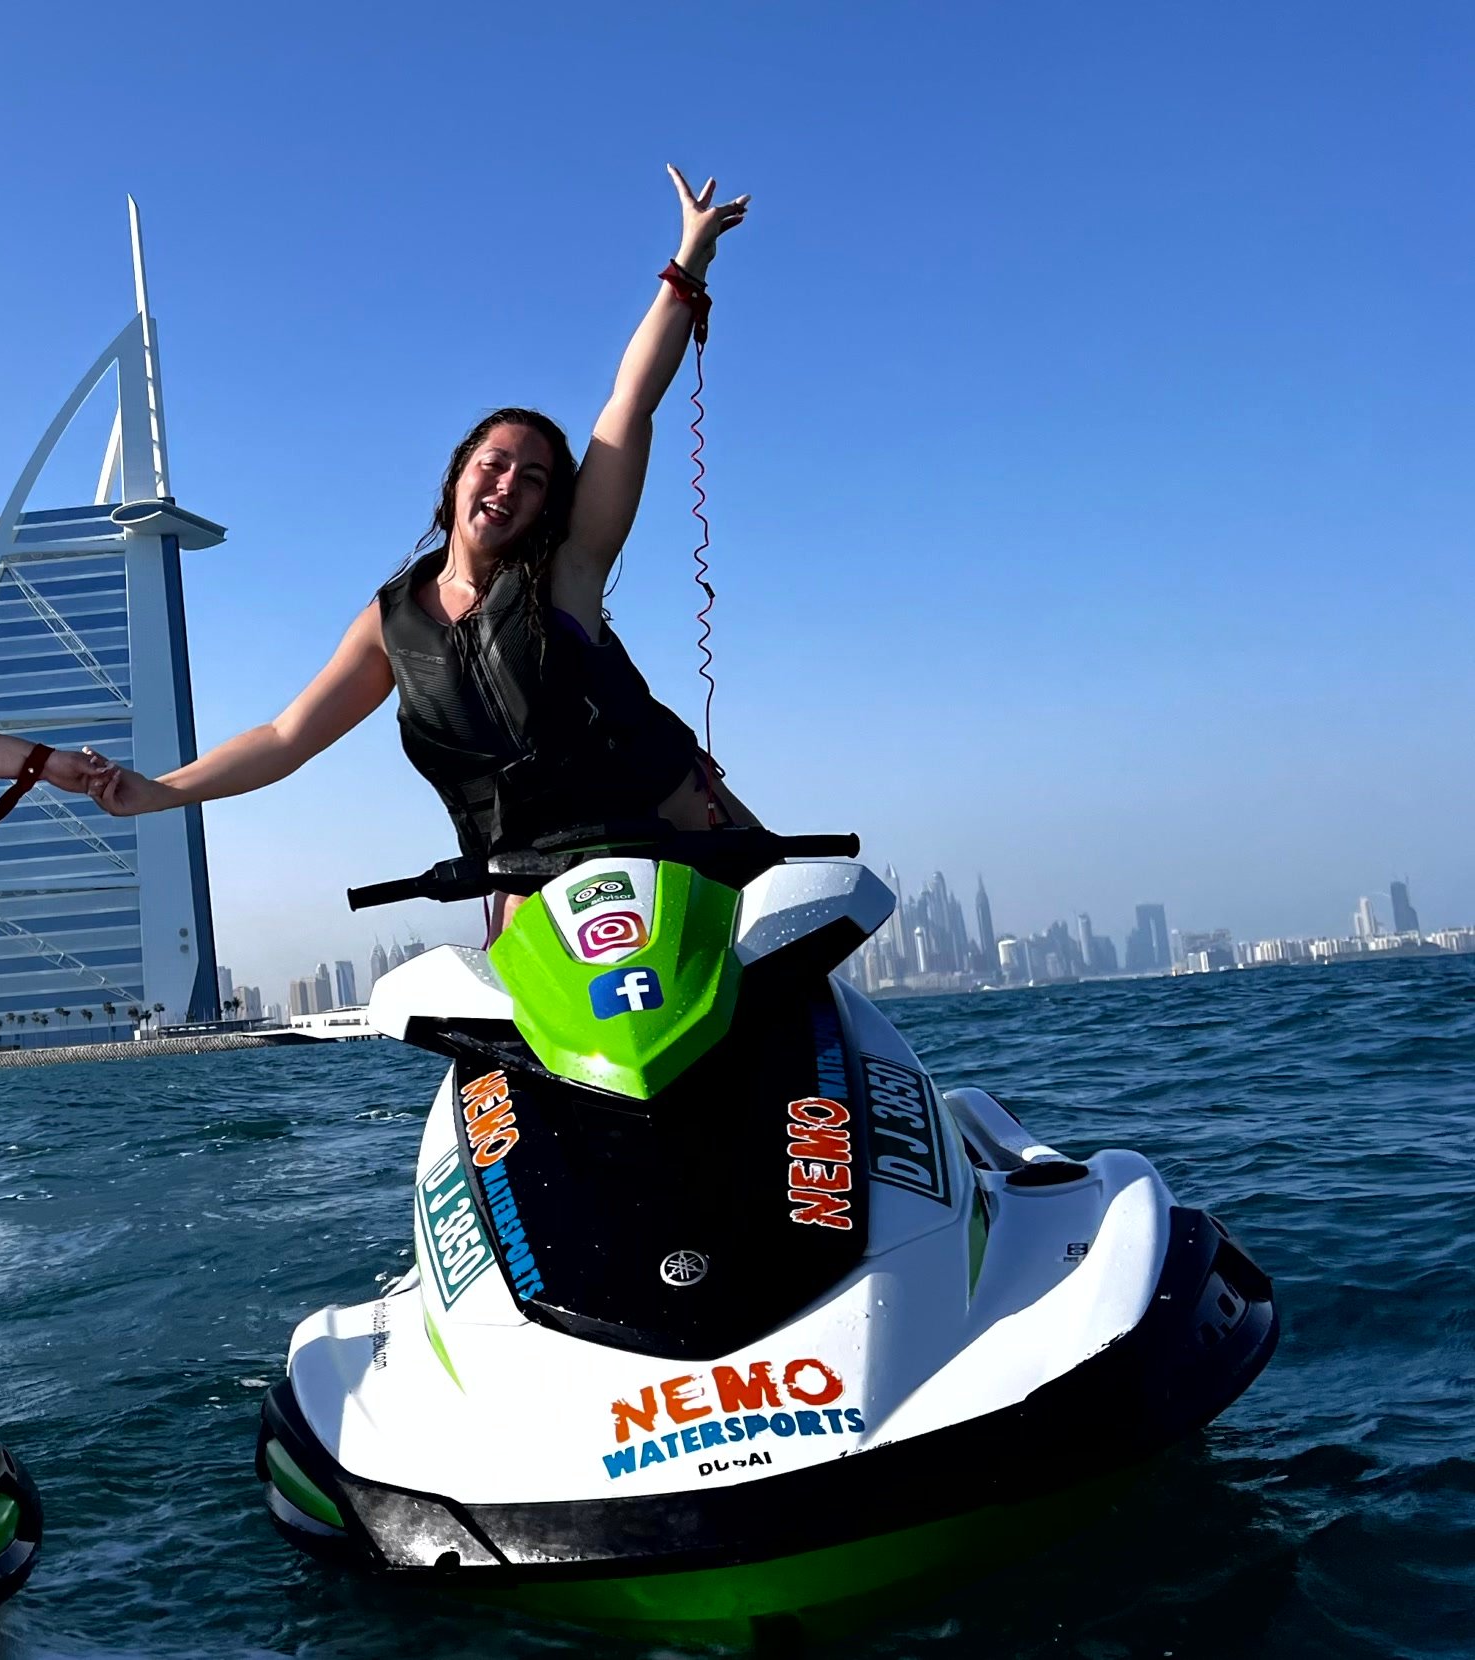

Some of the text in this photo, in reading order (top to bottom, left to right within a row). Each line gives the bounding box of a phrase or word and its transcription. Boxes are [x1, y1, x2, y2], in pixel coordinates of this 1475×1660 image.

[865, 1061, 925, 1130] 3850
[460, 1069, 544, 1301] NEMO WATERSPORTS
[787, 1097, 852, 1230] NEMO
[434, 1197, 486, 1286] 3850
[602, 1407, 866, 1479] WATERSPORTS
[611, 1358, 845, 1444] NEMO
